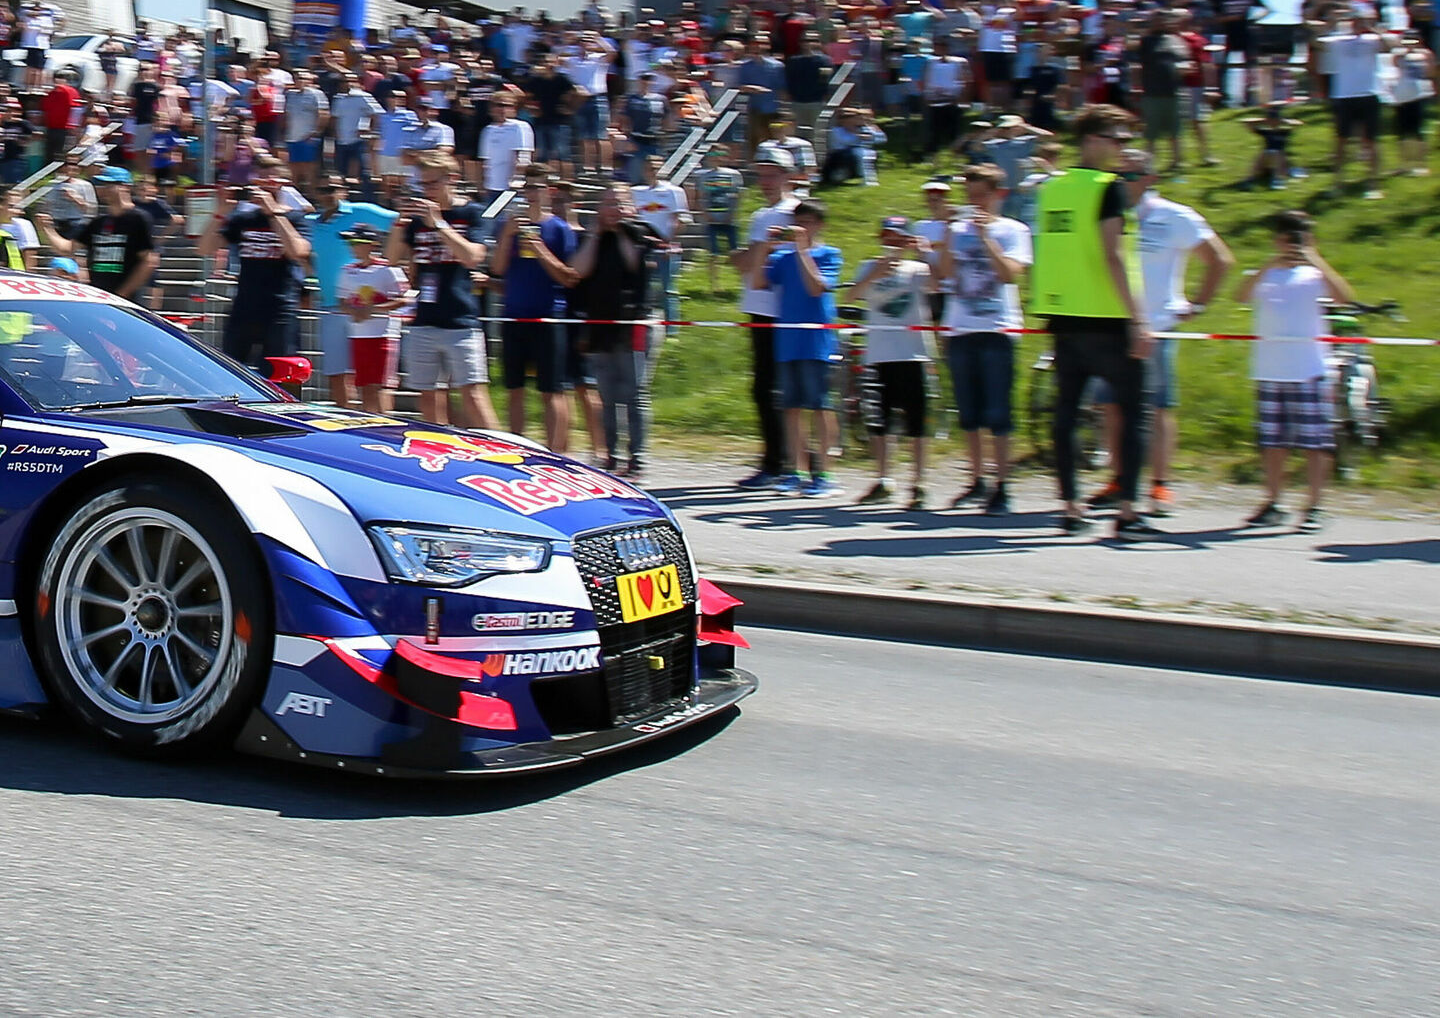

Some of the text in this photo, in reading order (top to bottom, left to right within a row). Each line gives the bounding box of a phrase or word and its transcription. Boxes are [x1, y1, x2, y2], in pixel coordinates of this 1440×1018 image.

[27, 445, 91, 457] Audi Sport
[7, 462, 64, 474] #RS5DTM
[526, 610, 576, 629] EDGE
[502, 646, 602, 676] Hankook
[274, 691, 333, 718] ABT
